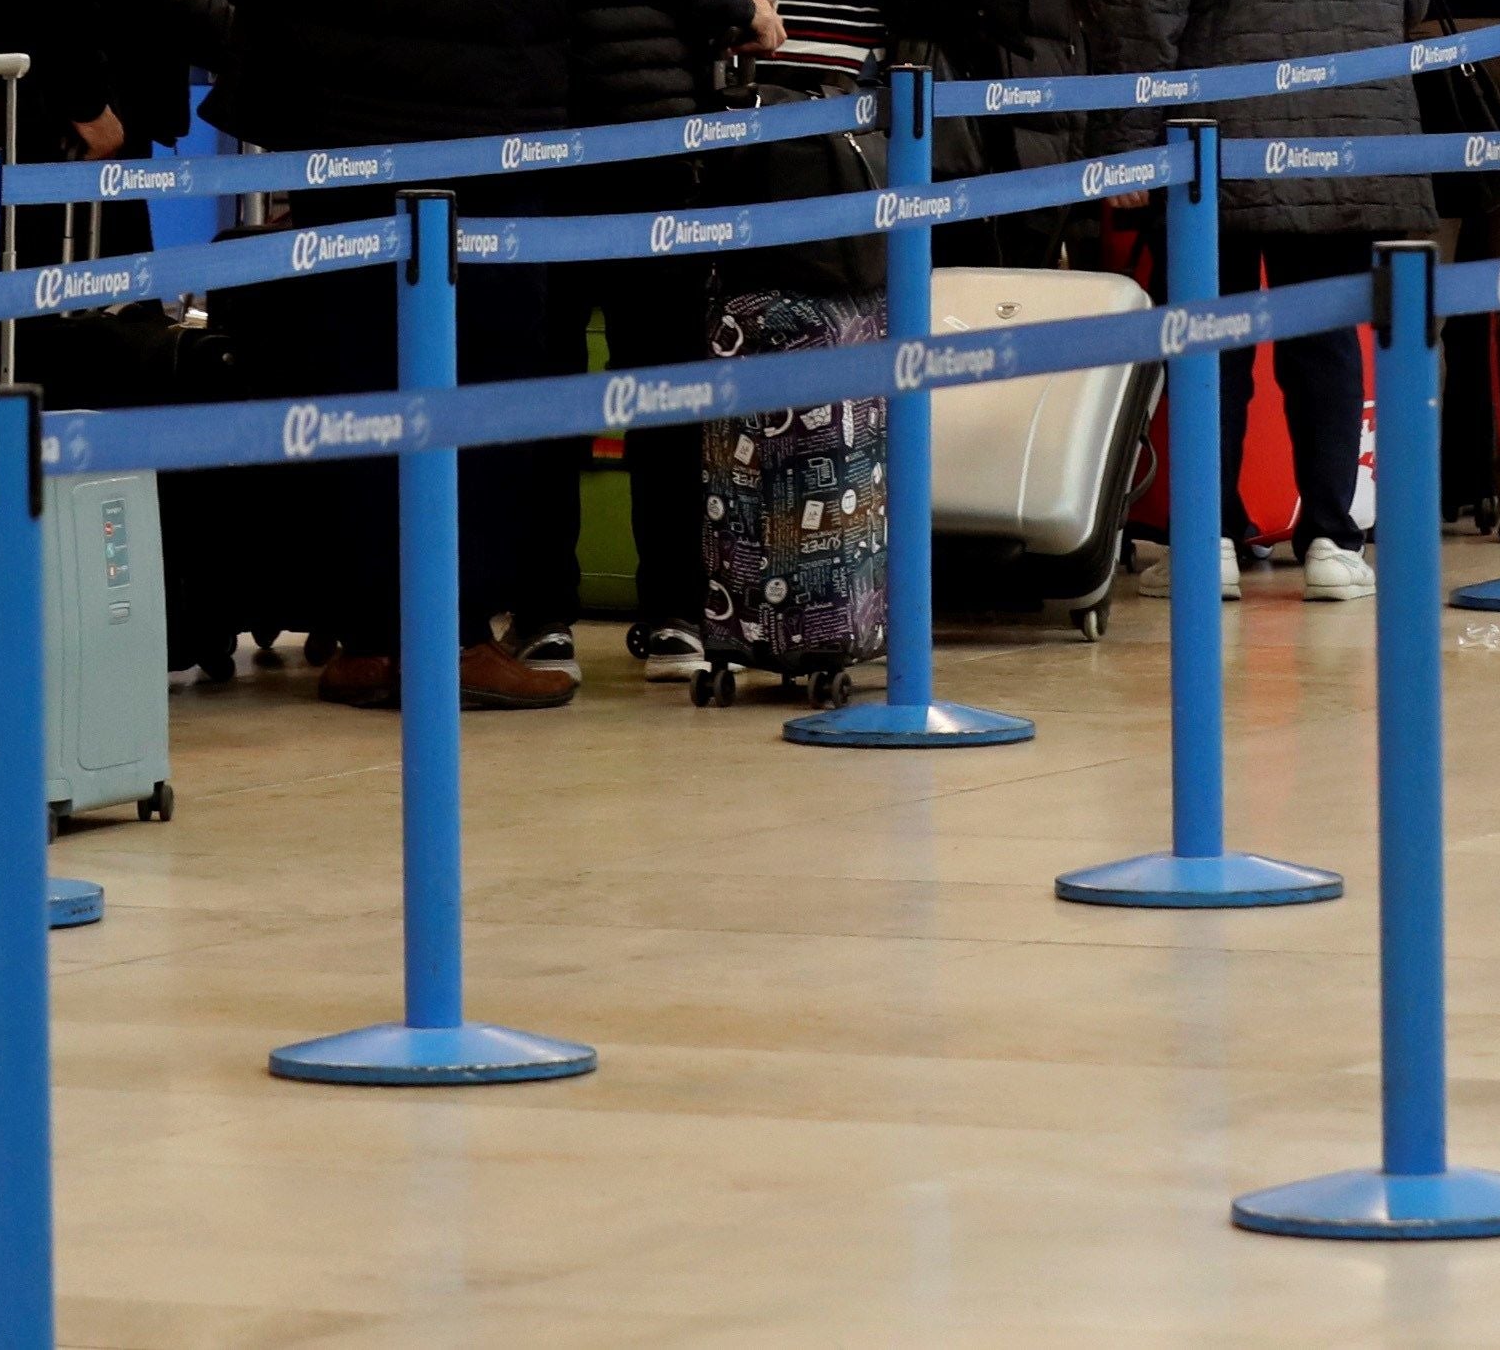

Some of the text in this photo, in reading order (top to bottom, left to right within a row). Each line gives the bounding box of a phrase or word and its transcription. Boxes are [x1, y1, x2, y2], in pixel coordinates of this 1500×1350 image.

[701, 121, 747, 142] AirEuropa
[522, 142, 569, 163] AirEuropa
[1286, 147, 1339, 171] AirEuropa
[327, 157, 378, 179] AirEuropa
[1104, 164, 1155, 185] AirEuropa
[121, 169, 176, 192] AirEuropa
[896, 196, 952, 220] AirEuropa
[675, 220, 734, 245] AirEuropa
[318, 234, 381, 261] AirEuropa
[63, 271, 131, 299] AirEuropa
[1188, 314, 1251, 341] AirEuropa
[924, 349, 995, 376] AirEuropa
[635, 381, 713, 413] AirEuropa
[318, 410, 403, 446] AirEuropa
